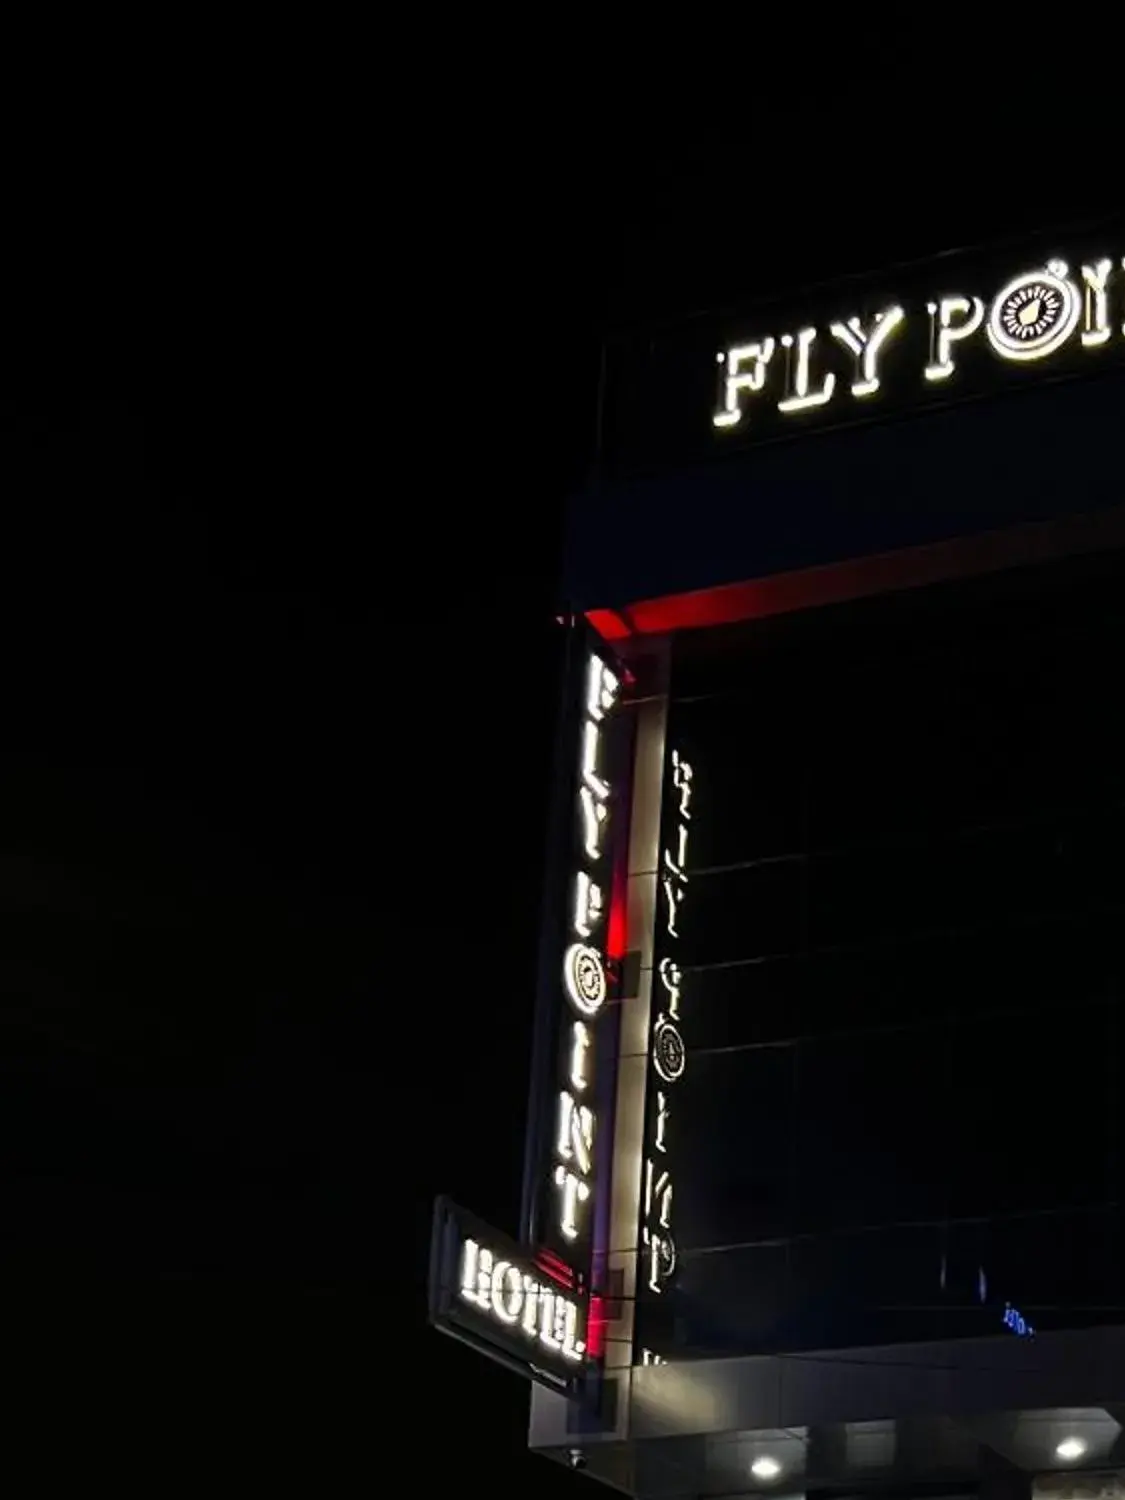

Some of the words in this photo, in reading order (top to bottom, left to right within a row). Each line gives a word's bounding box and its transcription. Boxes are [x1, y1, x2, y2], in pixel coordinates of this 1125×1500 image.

[712, 304, 906, 428] FLY
[577, 653, 619, 861] FLY
[554, 870, 608, 1241] POINT
[460, 1238, 587, 1362] HOTEL
